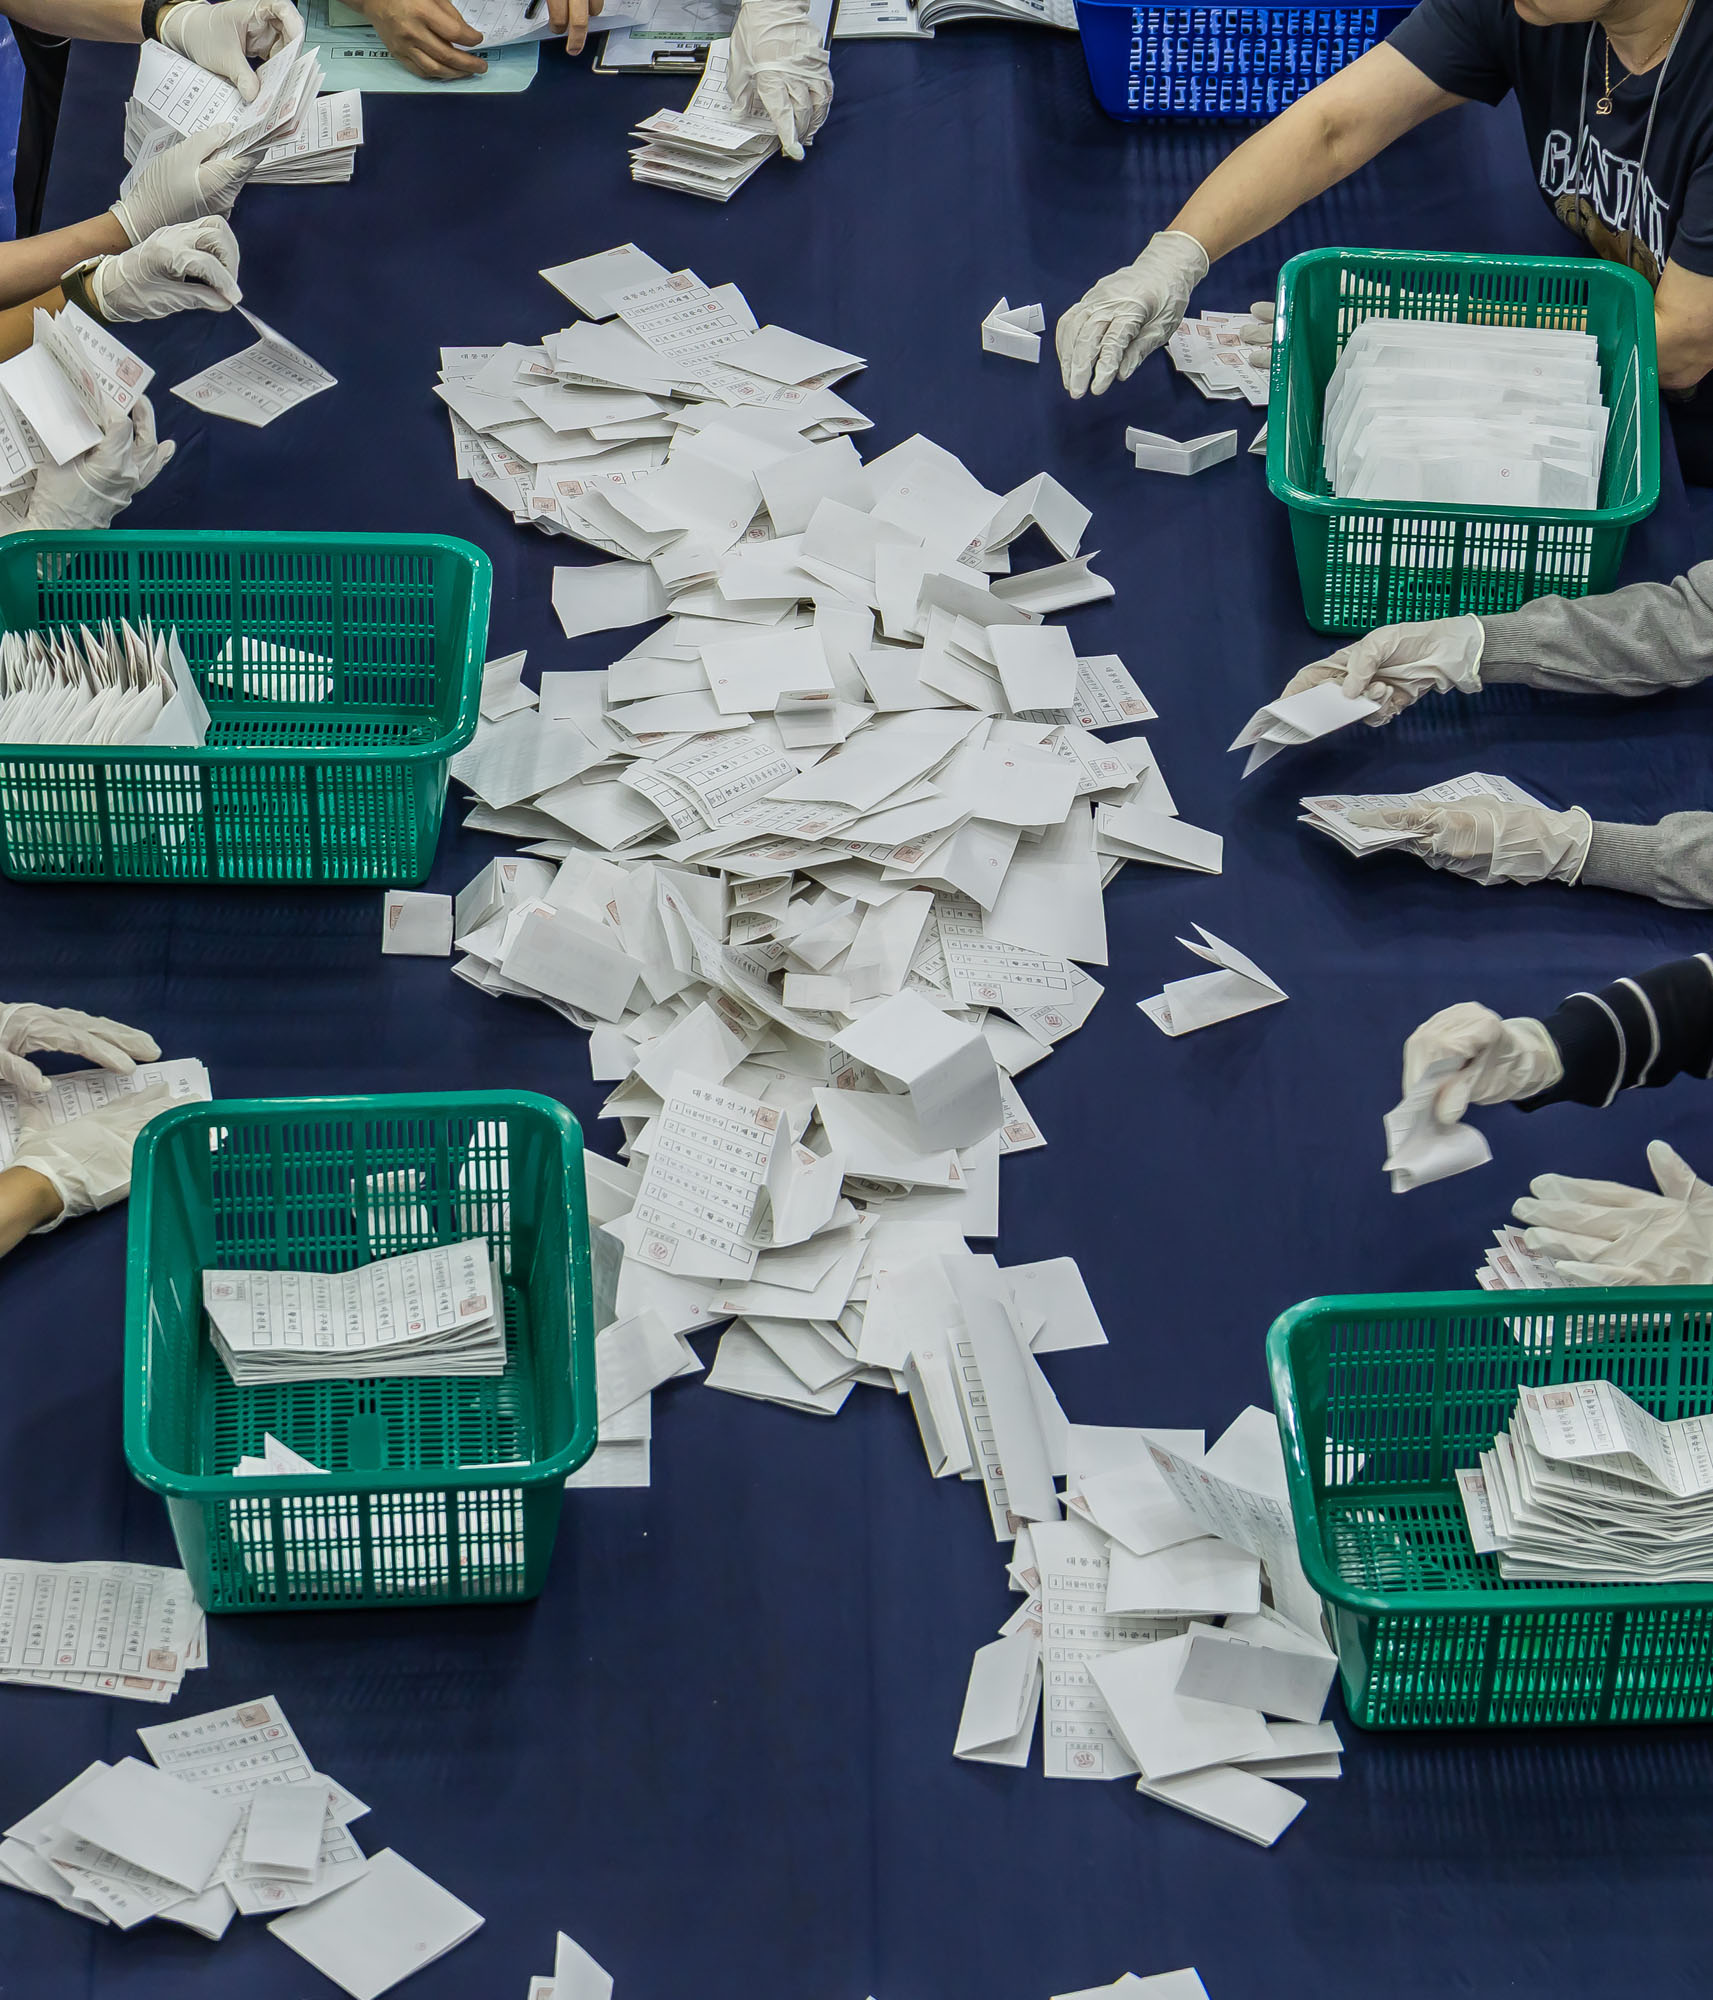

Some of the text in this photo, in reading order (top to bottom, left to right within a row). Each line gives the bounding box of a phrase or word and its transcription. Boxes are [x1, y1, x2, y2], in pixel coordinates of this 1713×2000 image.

[163, 70, 180, 91] 송진호
[184, 84, 201, 107] 황교안
[203, 100, 221, 122] 구주와
[668, 294, 691, 305] 이재명
[695, 321, 718, 332] 이준석
[20, 418, 36, 444] 황교안
[723, 782, 748, 797] 구주와
[730, 1123, 759, 1140] 이재명
[725, 1143, 753, 1159] 김문수
[719, 1161, 748, 1179] 이준석
[712, 1193, 740, 1211] 구주와
[706, 1211, 734, 1230] 황교안
[698, 1232, 728, 1251] 송진호
[1066, 1603, 1106, 1613] 국민의
[1118, 1630, 1150, 1640] 이준석
